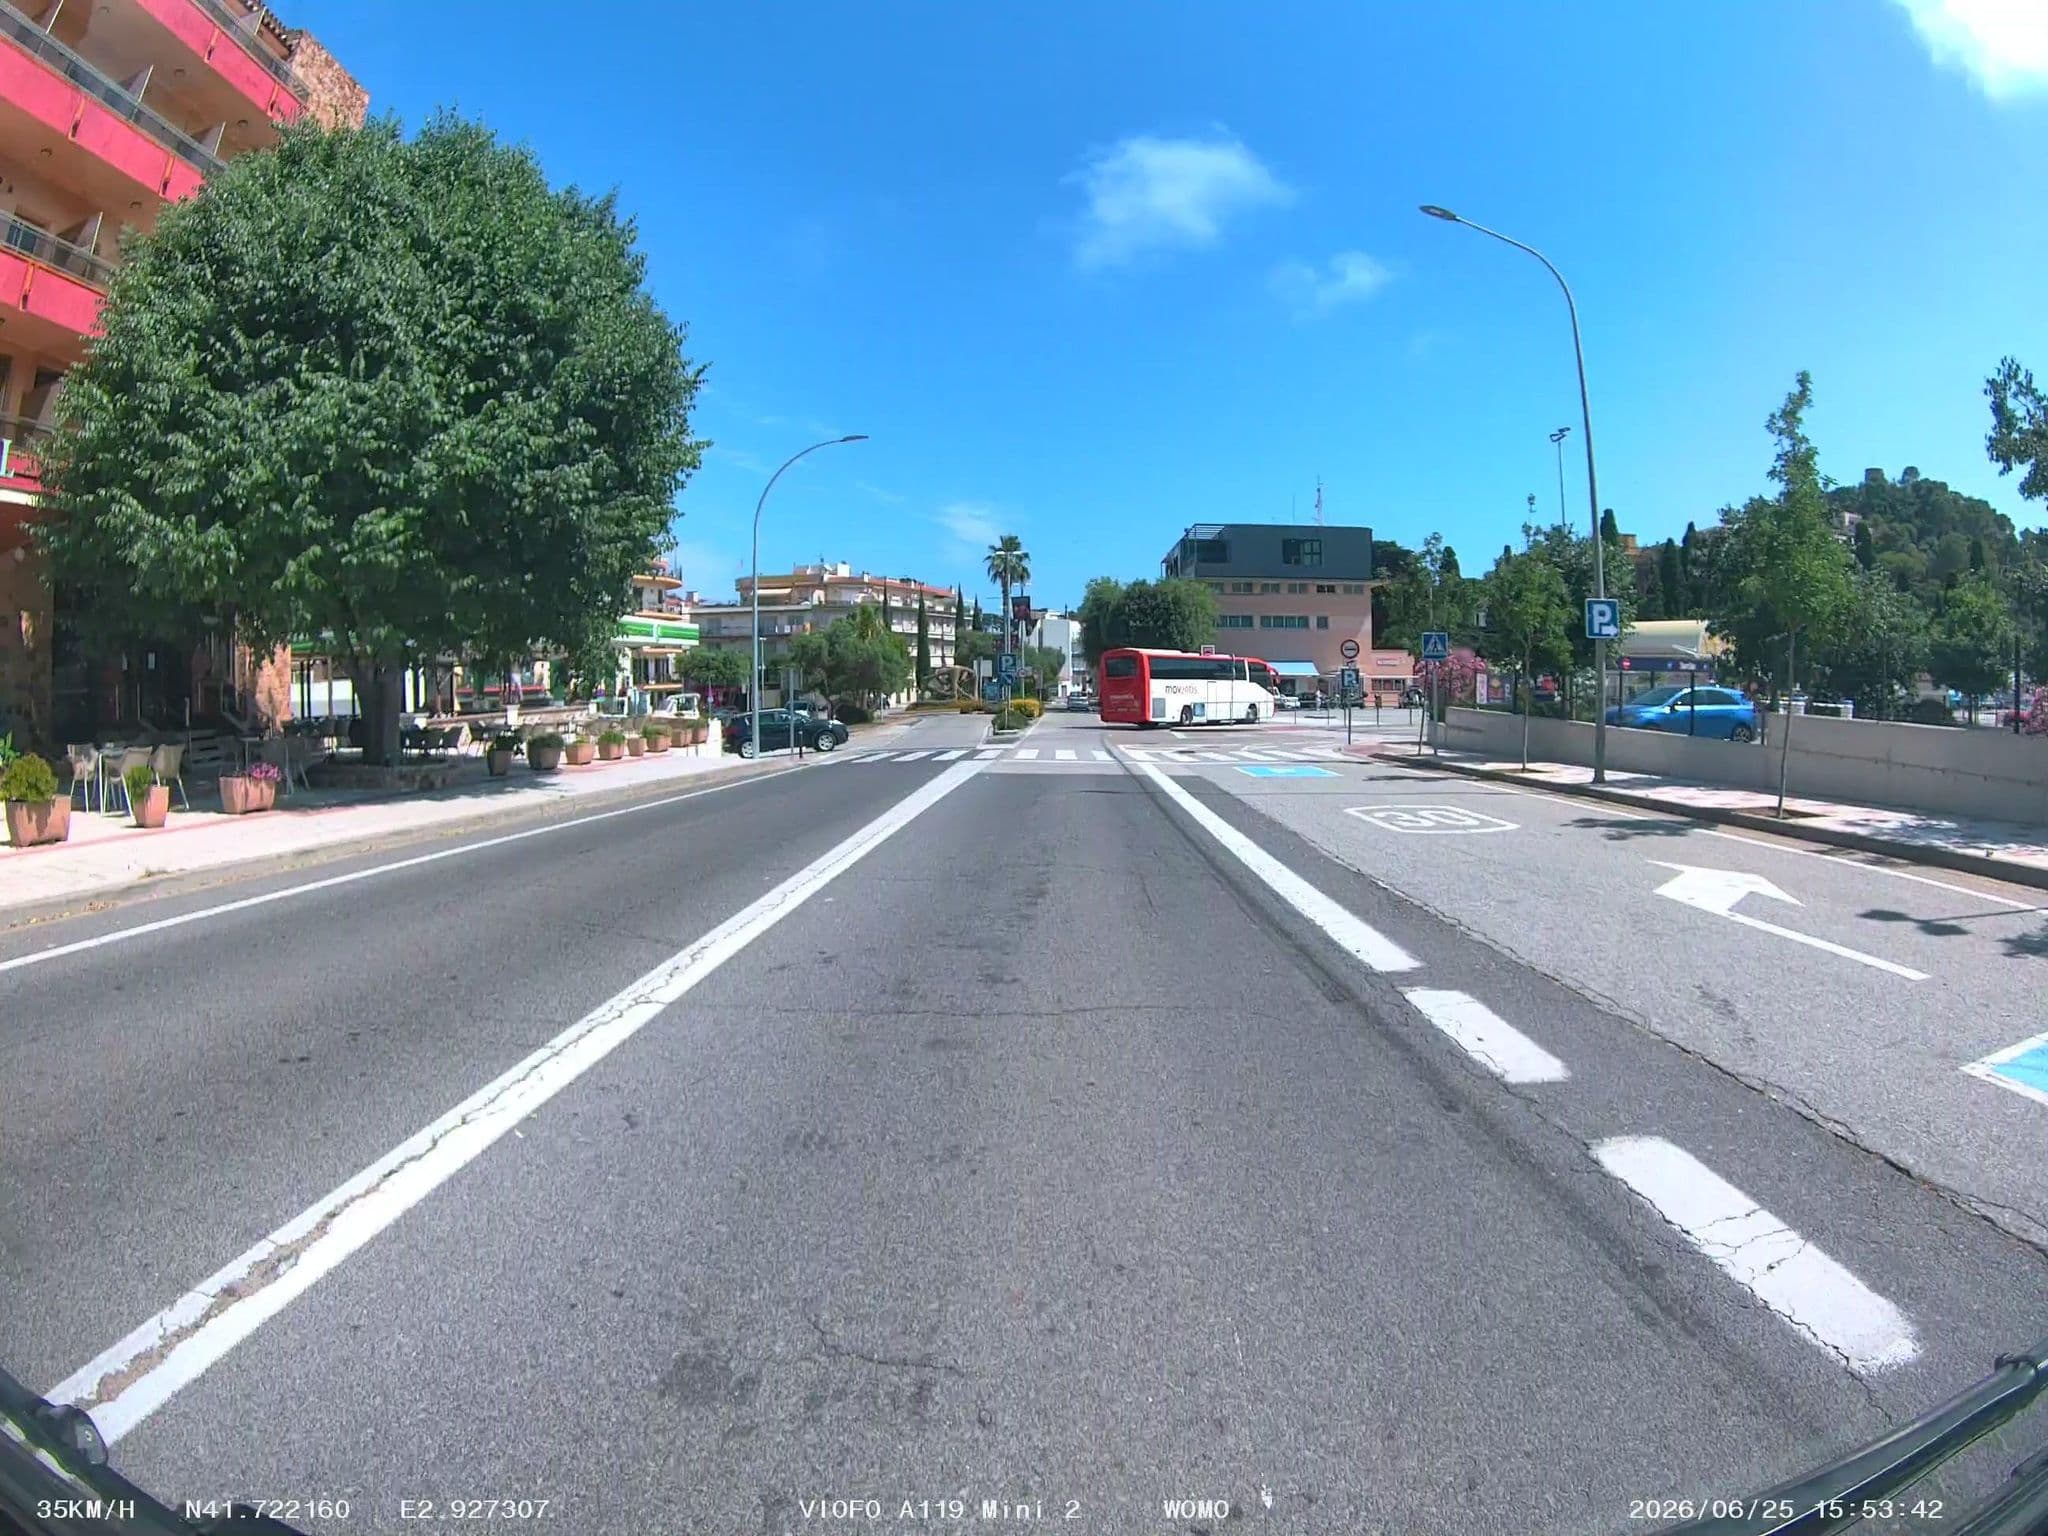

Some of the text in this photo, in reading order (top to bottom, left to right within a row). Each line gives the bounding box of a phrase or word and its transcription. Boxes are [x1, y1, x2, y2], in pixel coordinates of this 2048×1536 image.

[1592, 604, 1612, 634] P
[1344, 670, 1356, 687] P
[1373, 811, 1480, 827] 30
